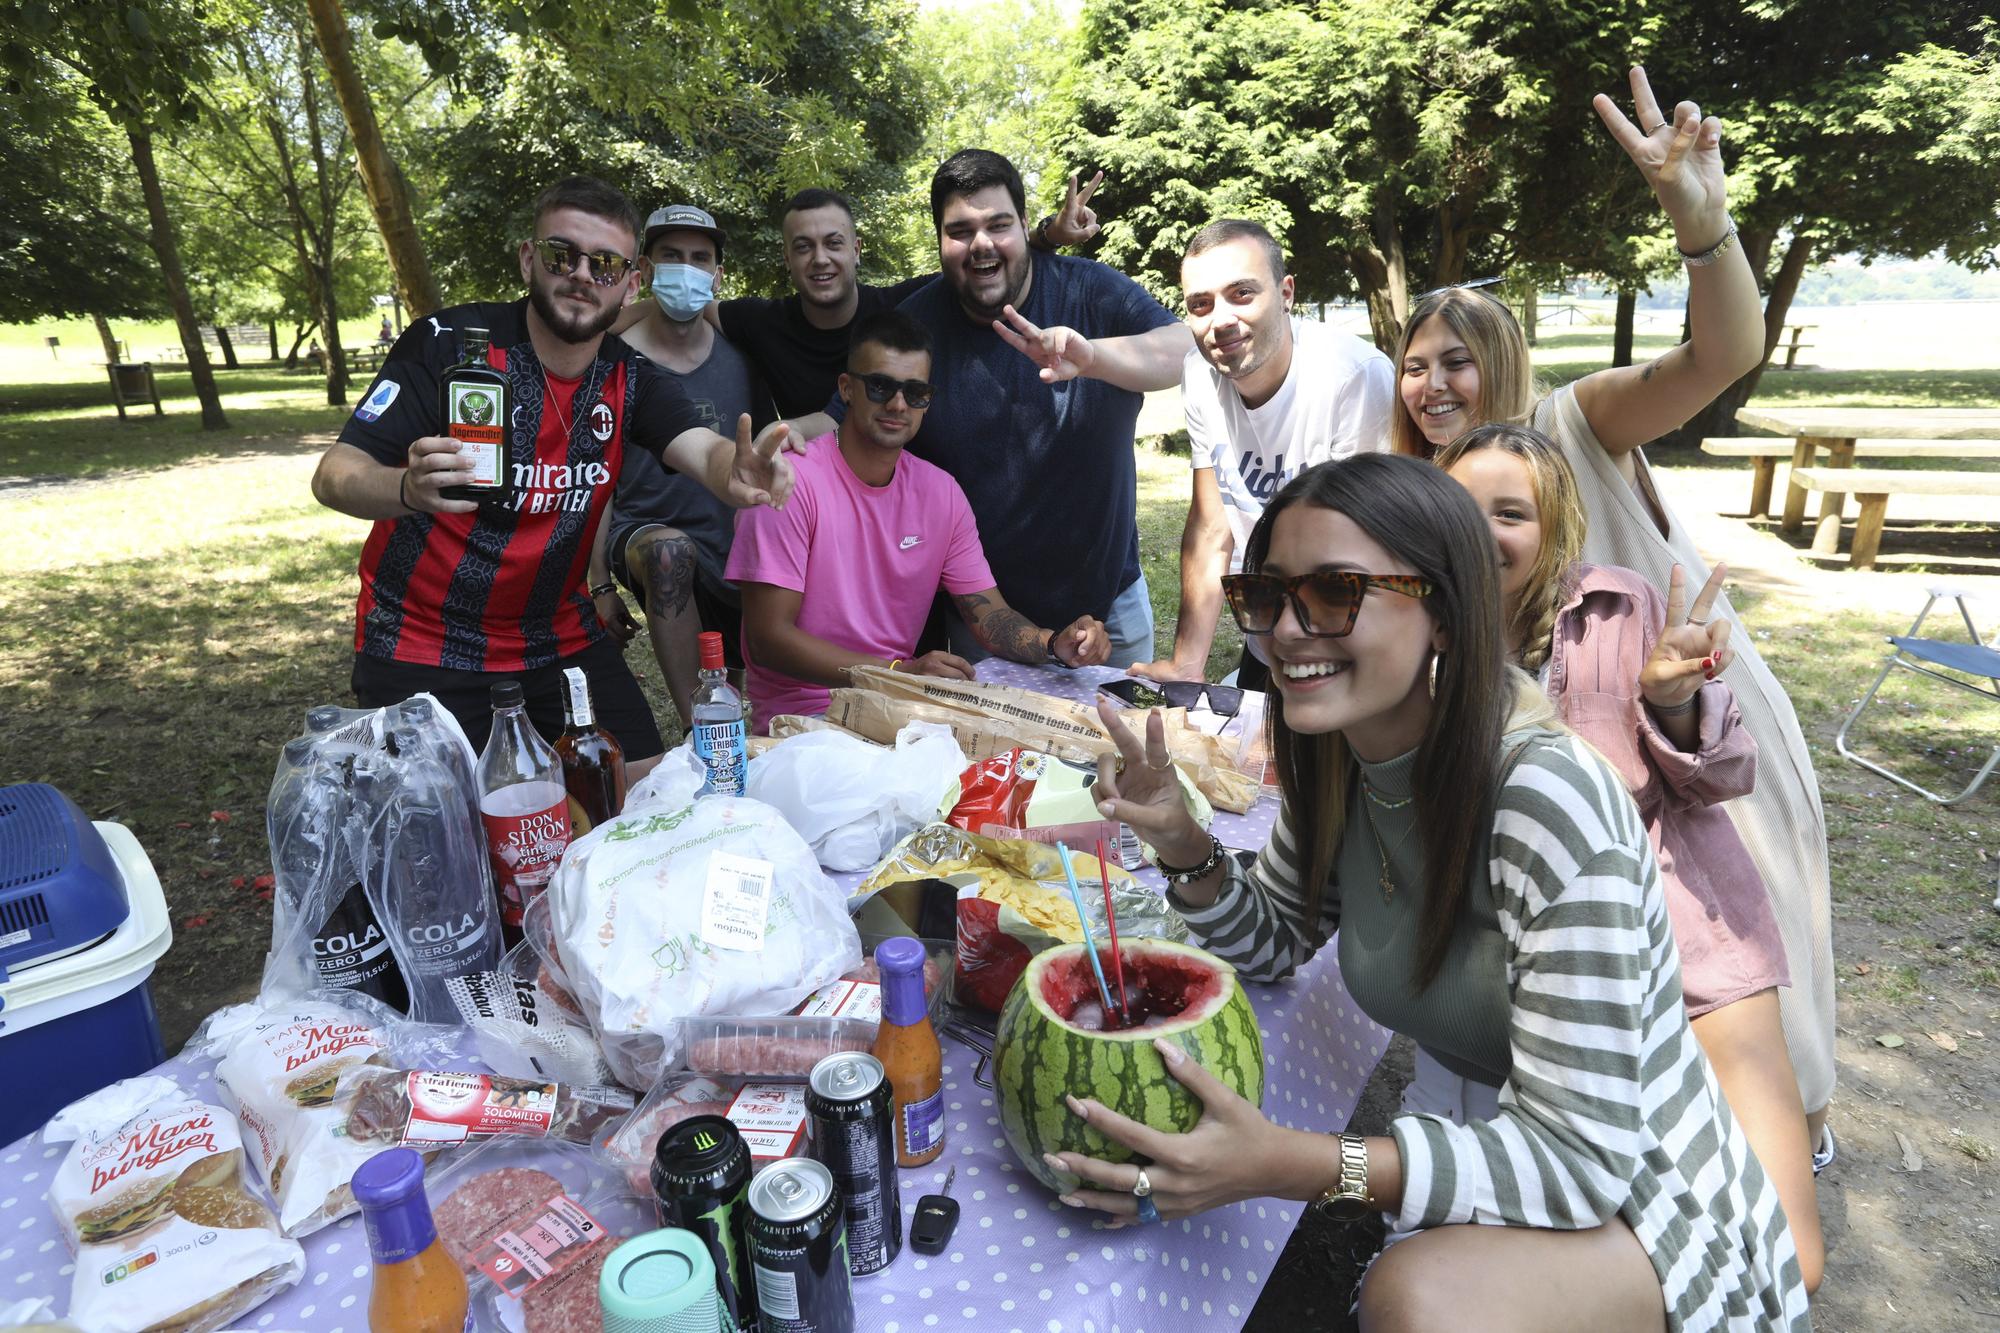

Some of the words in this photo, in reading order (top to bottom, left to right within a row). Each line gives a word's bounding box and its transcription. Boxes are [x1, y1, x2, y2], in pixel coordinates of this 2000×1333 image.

[668, 213, 704, 222] Supreme
[472, 444, 481, 453] 56
[512, 458, 610, 489] mirates
[529, 490, 591, 514] BETTER
[924, 684, 980, 706] Horneamos
[980, 697, 1001, 711] pan
[1002, 703, 1046, 725] durante
[1046, 716, 1071, 731] todo
[1072, 722, 1085, 734] el
[699, 724, 741, 740] TEQUILA
[704, 739, 739, 751] ESTRIBOS
[520, 811, 554, 832] DON
[508, 817, 565, 846] SIMON
[519, 843, 553, 857] tinto
[519, 847, 565, 866] verano
[408, 913, 475, 943] COLA
[311, 923, 381, 956] COLA
[417, 943, 454, 959] ZERO
[318, 953, 358, 971] ZERO
[484, 1107, 543, 1122] SOLOMILLO
[816, 1099, 864, 1113] VITAMINAS
[490, 1118, 512, 1126] CERDO
[81, 1147, 119, 1168] PARA
[118, 1113, 213, 1161] Maxi
[91, 1132, 218, 1195] burguer
[692, 1160, 734, 1185] TAURINA
[757, 1245, 804, 1257] MONSTER
